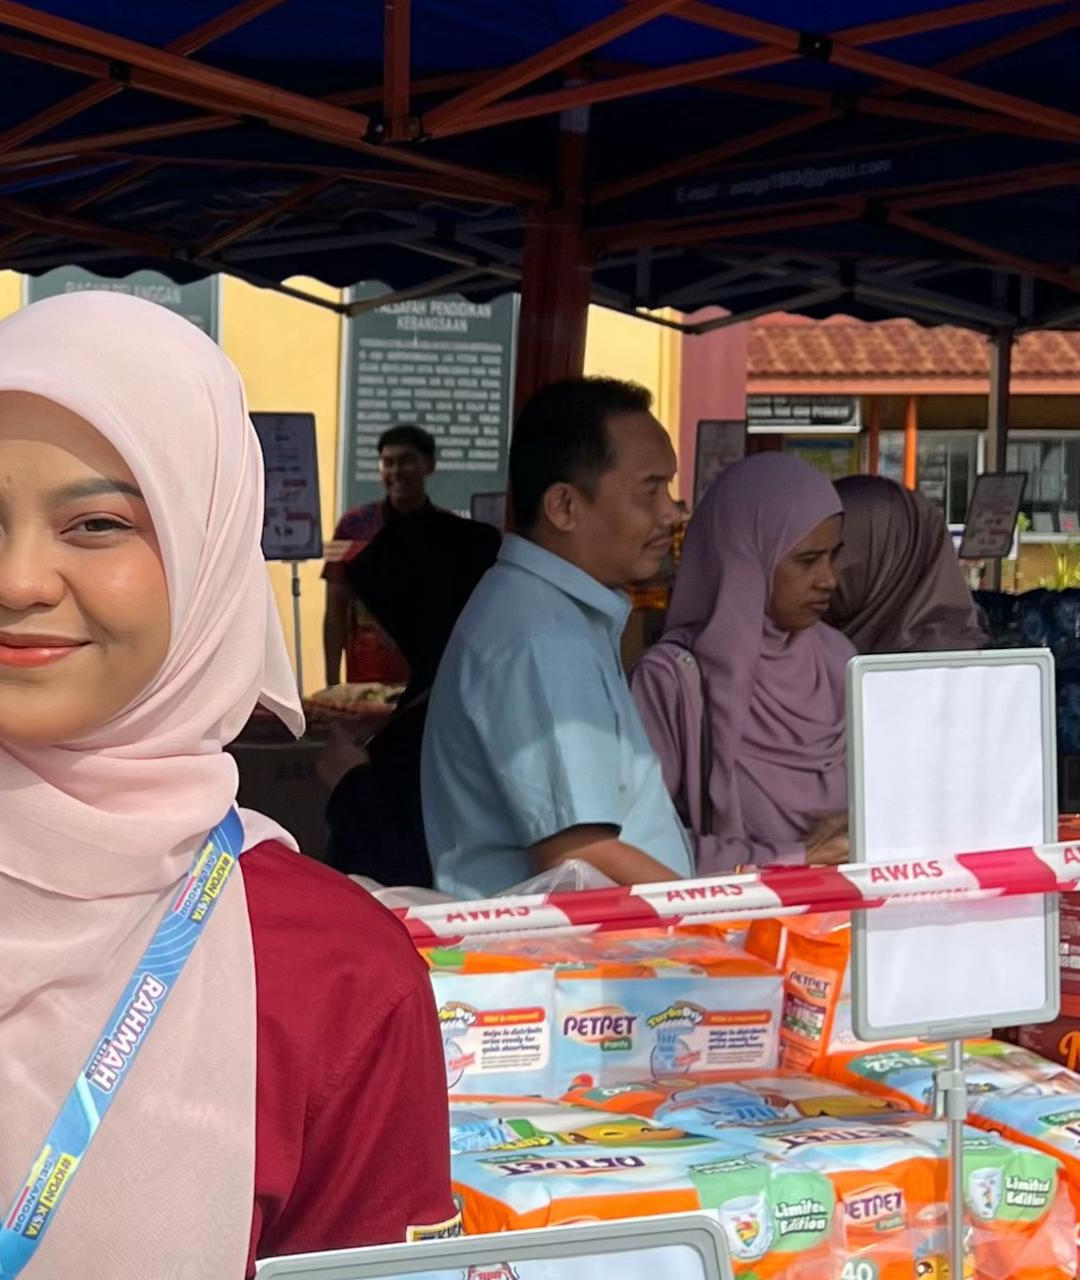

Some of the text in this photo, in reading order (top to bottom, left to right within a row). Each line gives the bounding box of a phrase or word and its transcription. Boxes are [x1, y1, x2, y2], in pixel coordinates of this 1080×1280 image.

[375, 300, 492, 318] ALSAFAH PENDIDIKAN
[396, 316, 468, 333] KEBANGSAAN
[870, 859, 944, 883] AWAS
[666, 883, 743, 903] AWAS
[92, 973, 166, 1092] RAHMAH
[563, 1015, 638, 1036] PETPET
[43, 1156, 72, 1204] #KPDN
[1004, 1175, 1050, 1195] Limited
[13, 1159, 53, 1233] SELANGOR
[845, 1191, 903, 1219] ETPET
[1005, 1189, 1048, 1208] Edition
[780, 1216, 827, 1237] Edition
